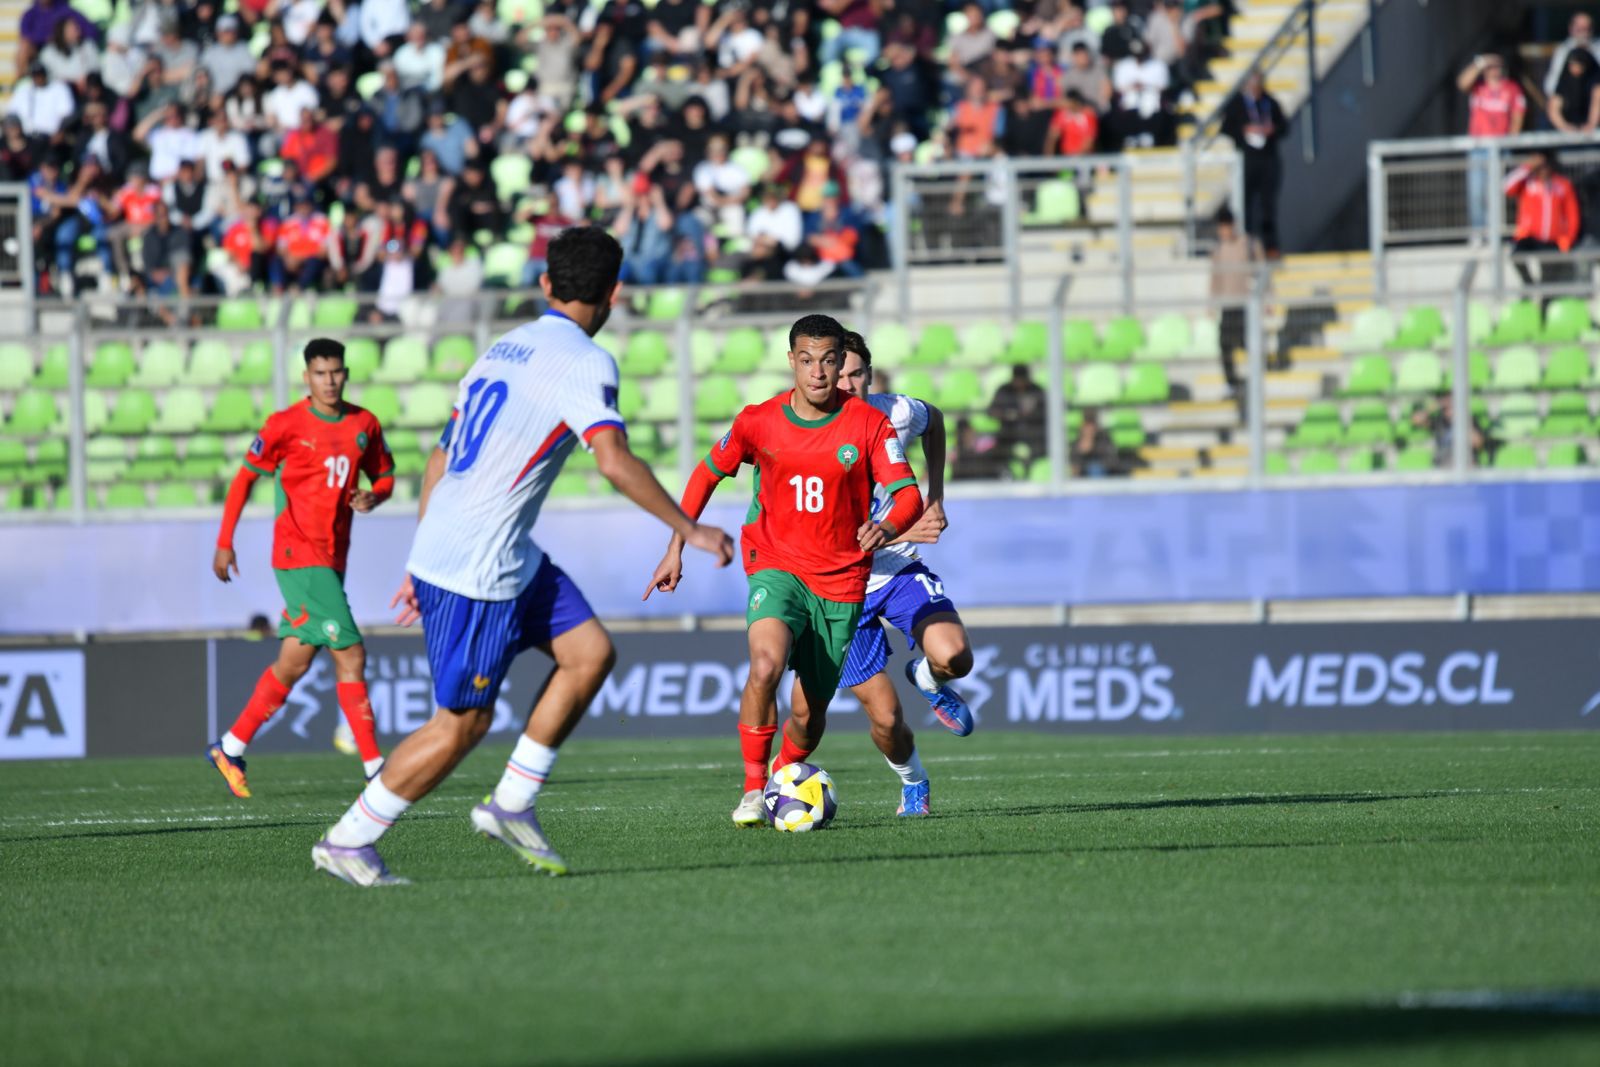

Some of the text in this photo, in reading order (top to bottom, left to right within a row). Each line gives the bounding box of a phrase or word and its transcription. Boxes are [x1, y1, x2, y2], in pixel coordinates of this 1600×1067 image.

[450, 377, 508, 473] 10
[324, 454, 350, 489] 19
[789, 474, 825, 514] 18
[0, 673, 67, 738] A
[1246, 650, 1514, 706] MEDS.CL
